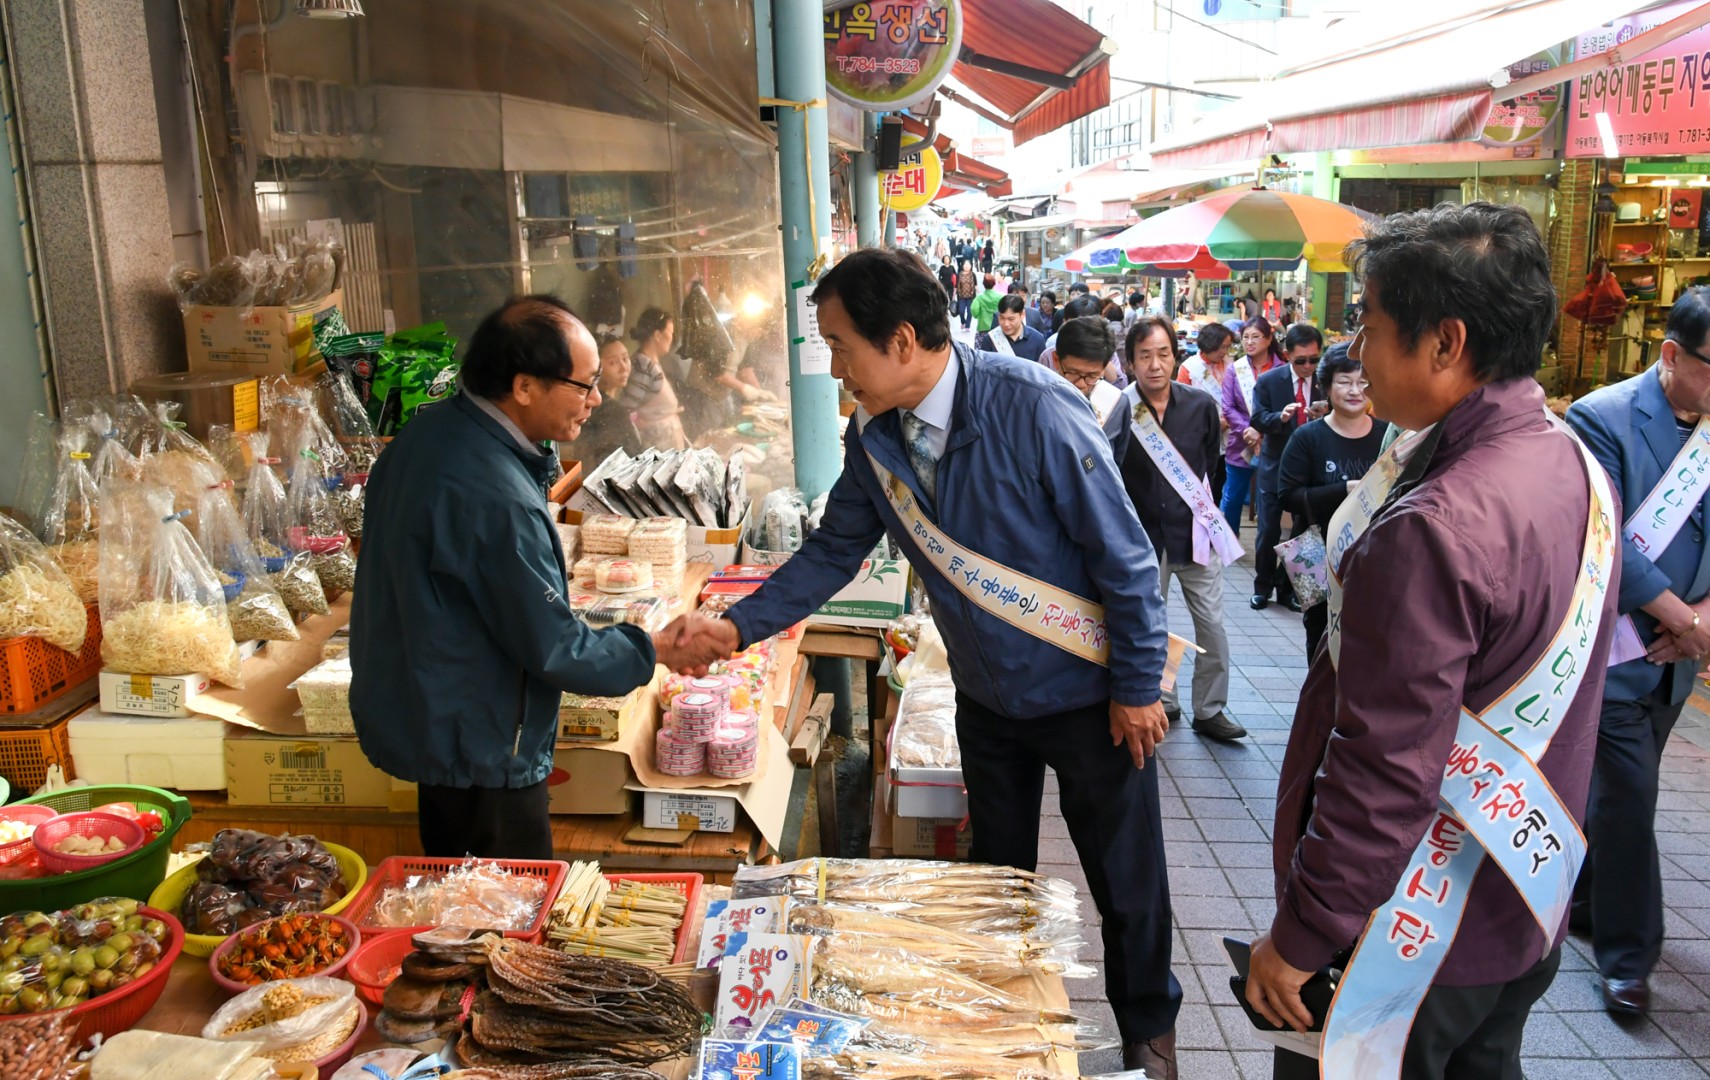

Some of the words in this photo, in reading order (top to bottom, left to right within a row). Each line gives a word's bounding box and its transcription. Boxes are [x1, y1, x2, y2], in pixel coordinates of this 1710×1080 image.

[836, 56, 920, 74] T.784-3523
[883, 168, 926, 195] 순대
[913, 519, 945, 555] 명절
[948, 556, 1040, 616] 제수용품은
